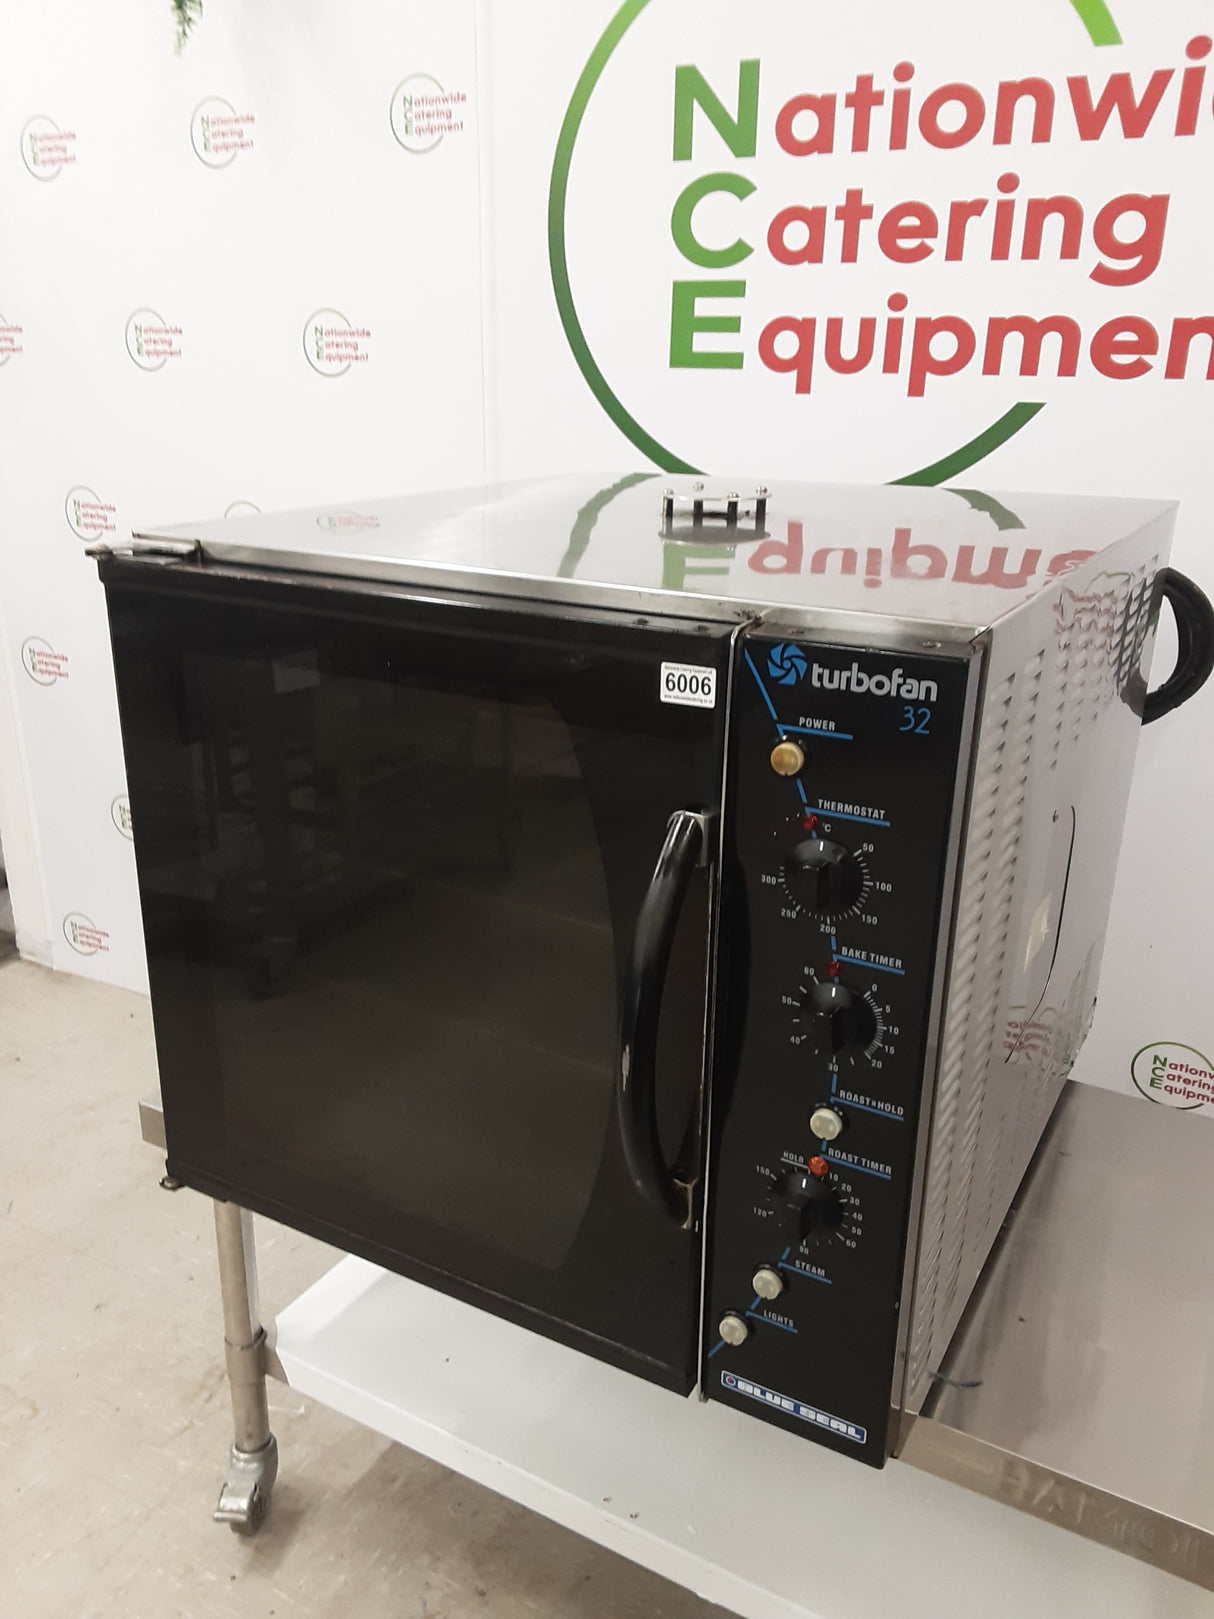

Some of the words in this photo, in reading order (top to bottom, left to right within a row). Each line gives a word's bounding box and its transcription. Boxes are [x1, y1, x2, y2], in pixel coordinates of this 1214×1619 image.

[403, 91, 467, 110] Nationwide
[672, 35, 1214, 162] Nationwi
[404, 108, 452, 122] Catering
[404, 119, 464, 137] Equipment
[671, 171, 1171, 287] Catering
[665, 672, 711, 696] 6006
[811, 663, 938, 702] turbofan
[799, 716, 836, 732] POWER
[899, 706, 932, 734] 32
[818, 798, 886, 821] THERMOSTAT
[863, 843, 874, 853] 50
[761, 874, 777, 885] 300
[875, 881, 892, 892] 100
[781, 908, 797, 919] 250
[862, 914, 878, 925] 150
[820, 924, 836, 935] 200
[841, 945, 868, 962] BAKE
[869, 952, 903, 969] TIMER
[872, 983, 878, 992] 0
[782, 996, 792, 1005] 50
[885, 1005, 891, 1013] 5
[889, 1025, 899, 1035] 10
[790, 1035, 800, 1045] 40
[884, 1045, 895, 1055] 15
[828, 1063, 839, 1072] 30
[871, 1059, 882, 1069] 20
[839, 1089, 871, 1107] ROAST
[877, 1100, 904, 1116] HOLD
[783, 1151, 804, 1164] HOLD
[828, 1147, 859, 1164] ROAST
[861, 1157, 892, 1175] TIMER
[829, 1173, 839, 1182] 10
[841, 1183, 852, 1192] 20
[850, 1196, 860, 1206] 30
[852, 1212, 862, 1221] 40
[851, 1225, 862, 1235] 50
[795, 1259, 826, 1277] STEAM
[763, 1309, 794, 1328] LIGHTS
[737, 1380, 794, 1411] BLUE
[799, 1405, 862, 1439] SEAL
